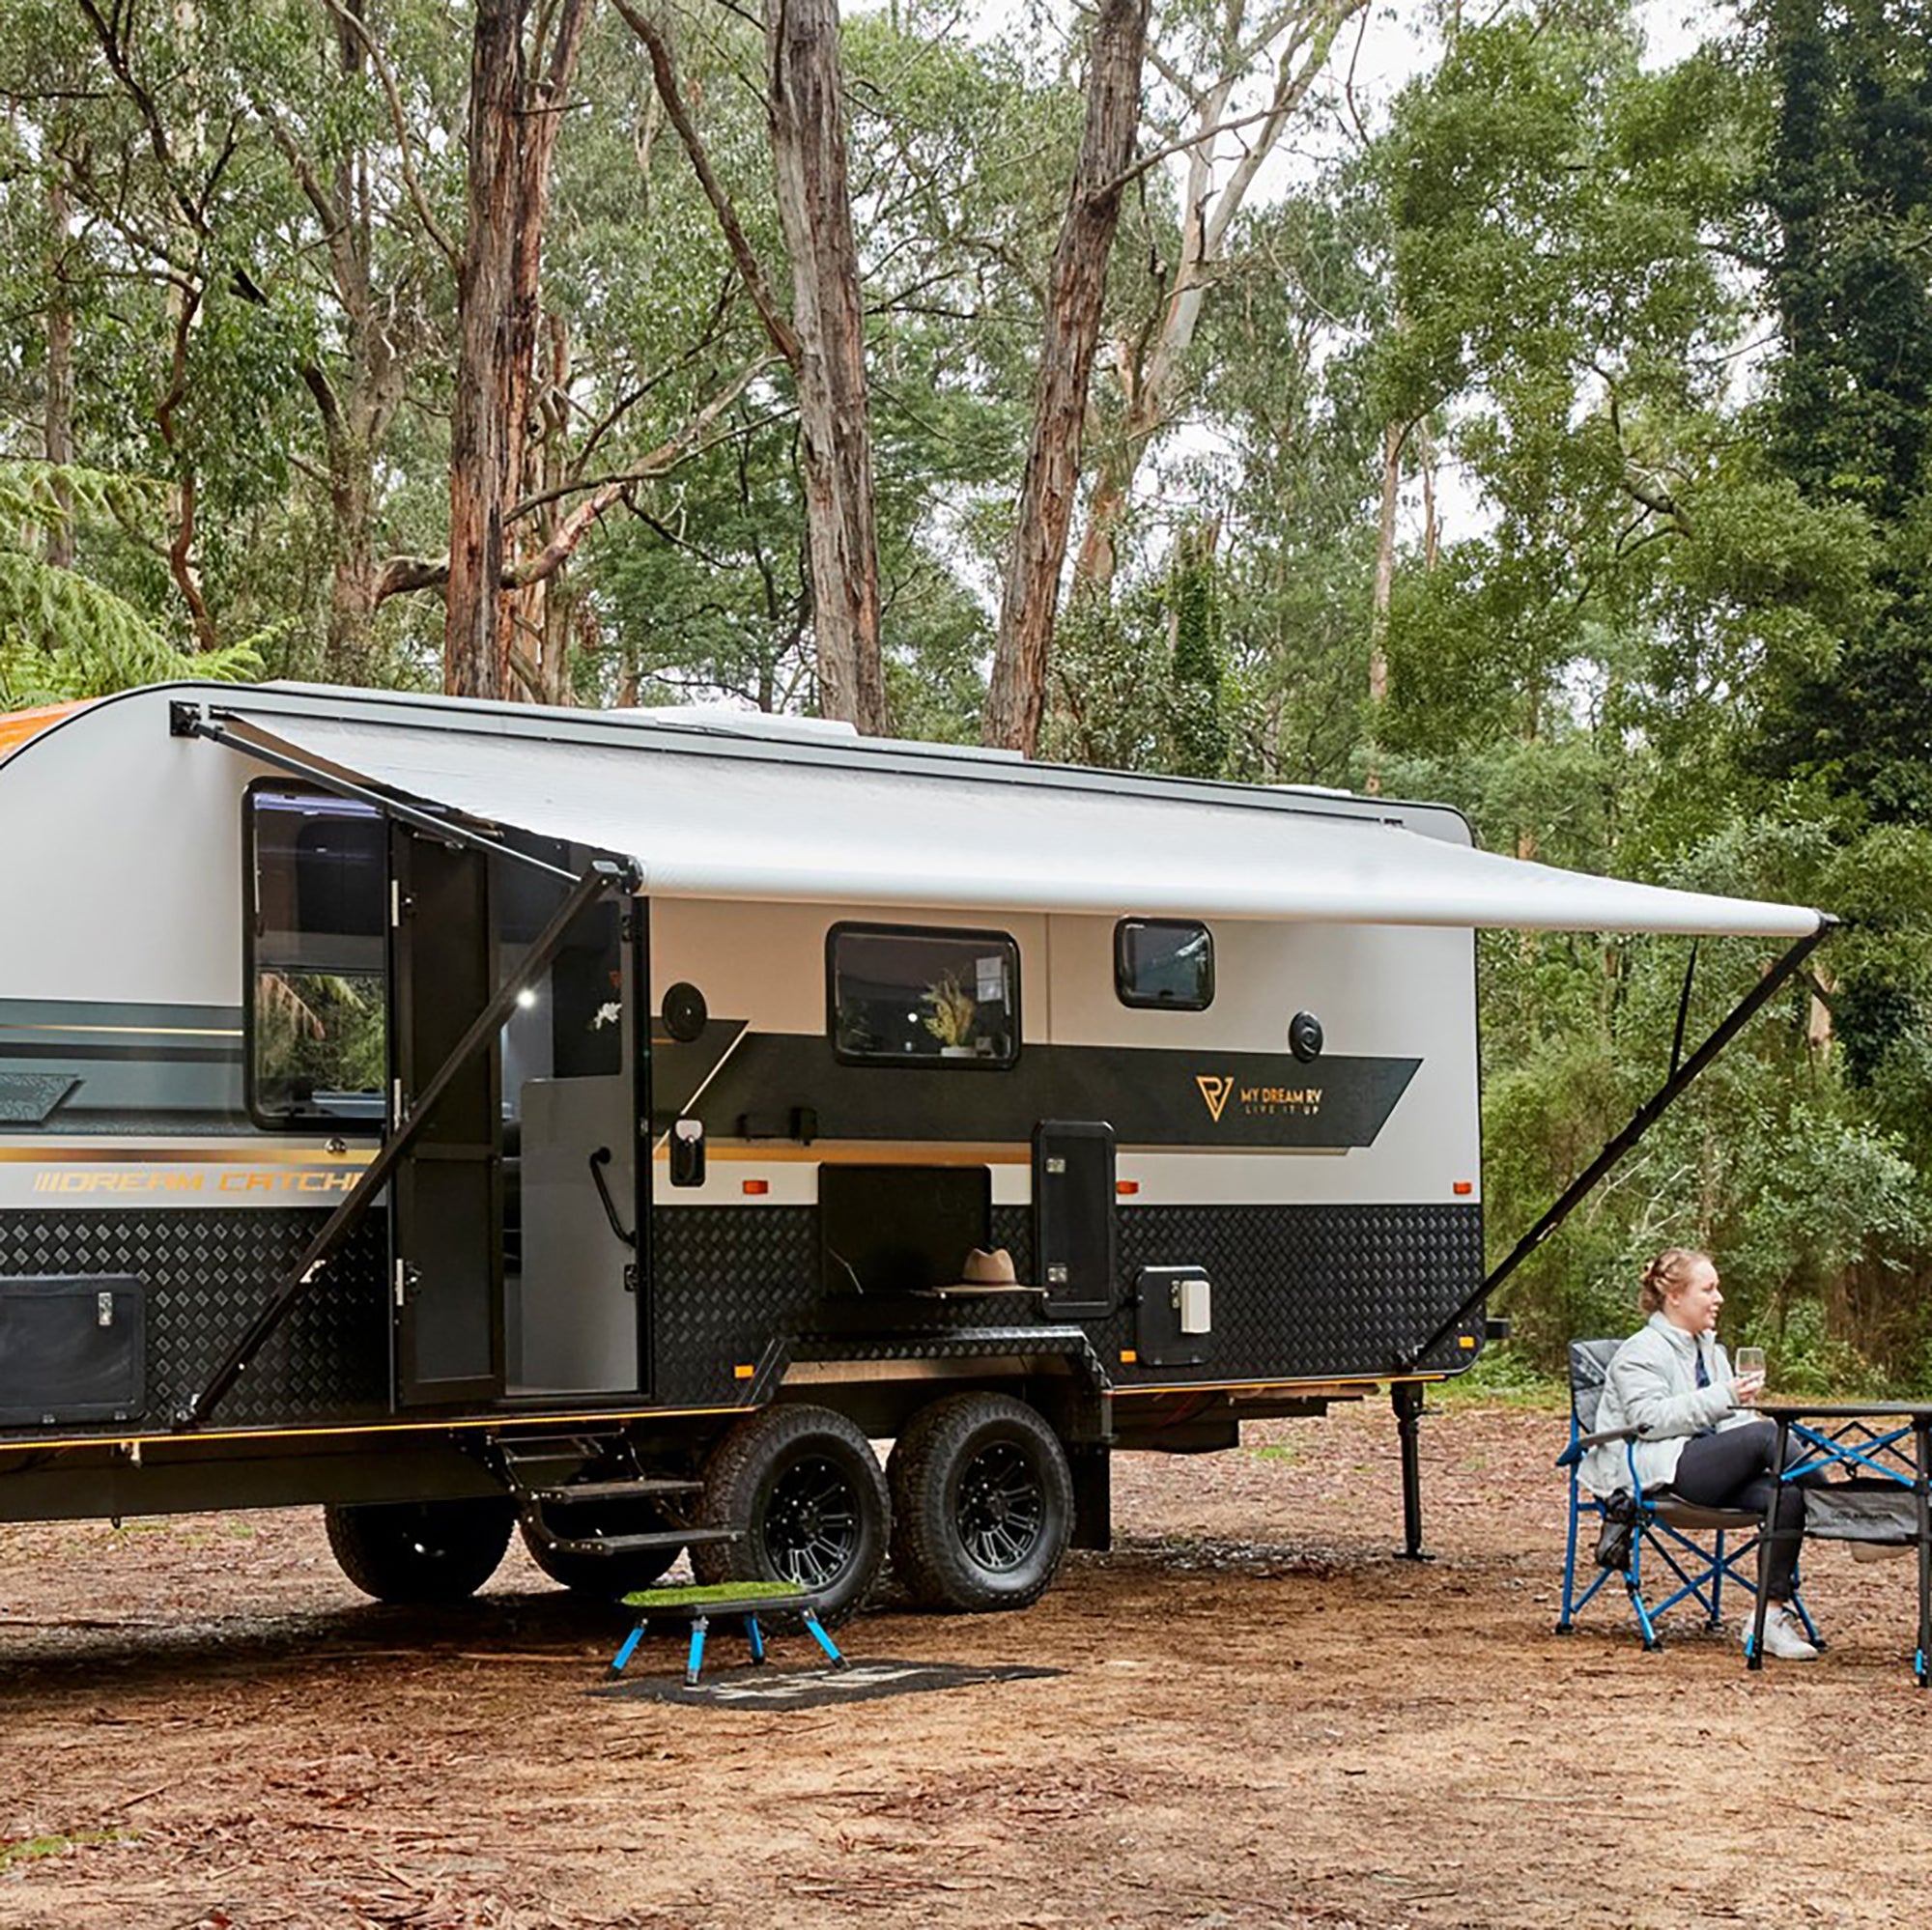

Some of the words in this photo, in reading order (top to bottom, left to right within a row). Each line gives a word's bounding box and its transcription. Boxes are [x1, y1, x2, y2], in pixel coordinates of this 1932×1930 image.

[1240, 1088, 1260, 1103] MY
[1262, 1088, 1304, 1103] DREAM
[1306, 1089, 1322, 1104] RV
[1283, 1104, 1295, 1115] IT
[1303, 1104, 1320, 1116] UP
[58, 1172, 205, 1191] DREAM
